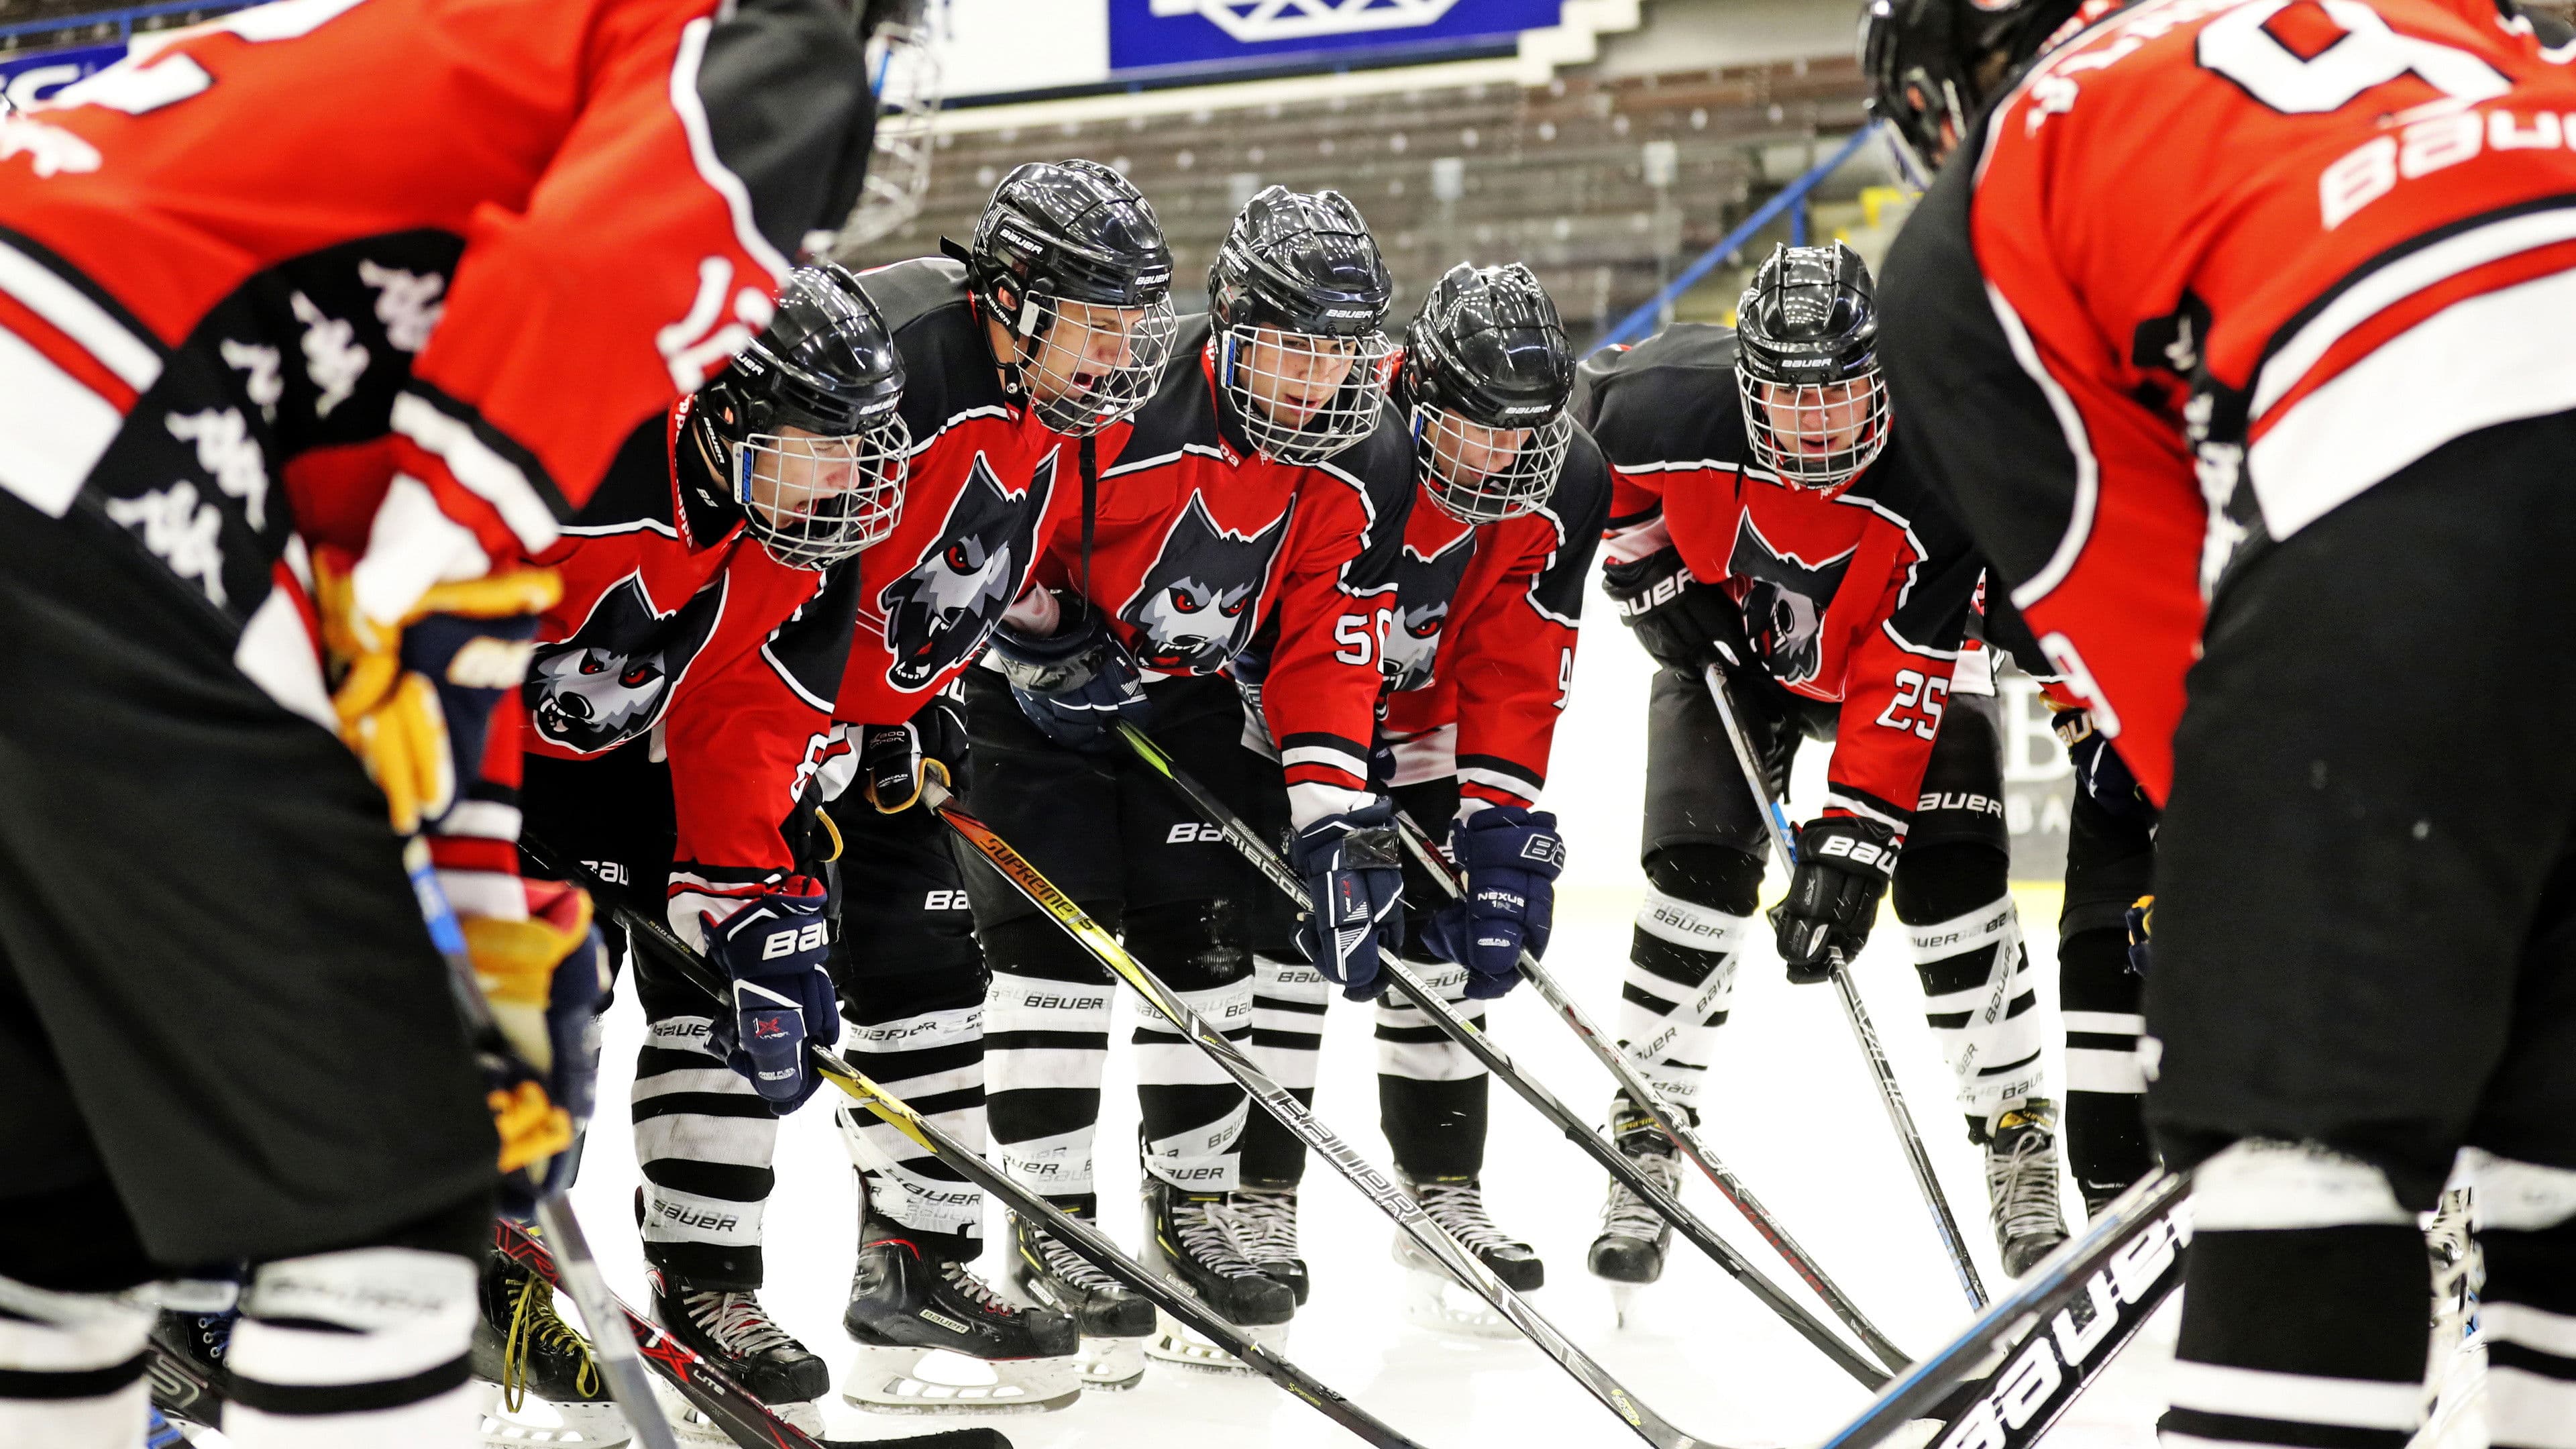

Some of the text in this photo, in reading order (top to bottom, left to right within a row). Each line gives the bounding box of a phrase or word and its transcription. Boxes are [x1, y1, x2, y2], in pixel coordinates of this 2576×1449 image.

[1000, 228, 1044, 255] BAUER
[1134, 272, 1171, 285] BAUER
[985, 292, 1012, 326] BAUER
[1325, 309, 1375, 319] BAUER
[1781, 358, 1833, 368] BAUER
[859, 393, 900, 415] BAUER
[1505, 405, 1552, 414] BAUER
[704, 417, 725, 464] BAUER
[1876, 668, 1950, 741] 25
[1478, 892, 1525, 908] NEXUS
[1023, 996, 1104, 1010] BAUER
[923, 1309, 967, 1332] BAUER
[693, 1369, 725, 1396] LITE
